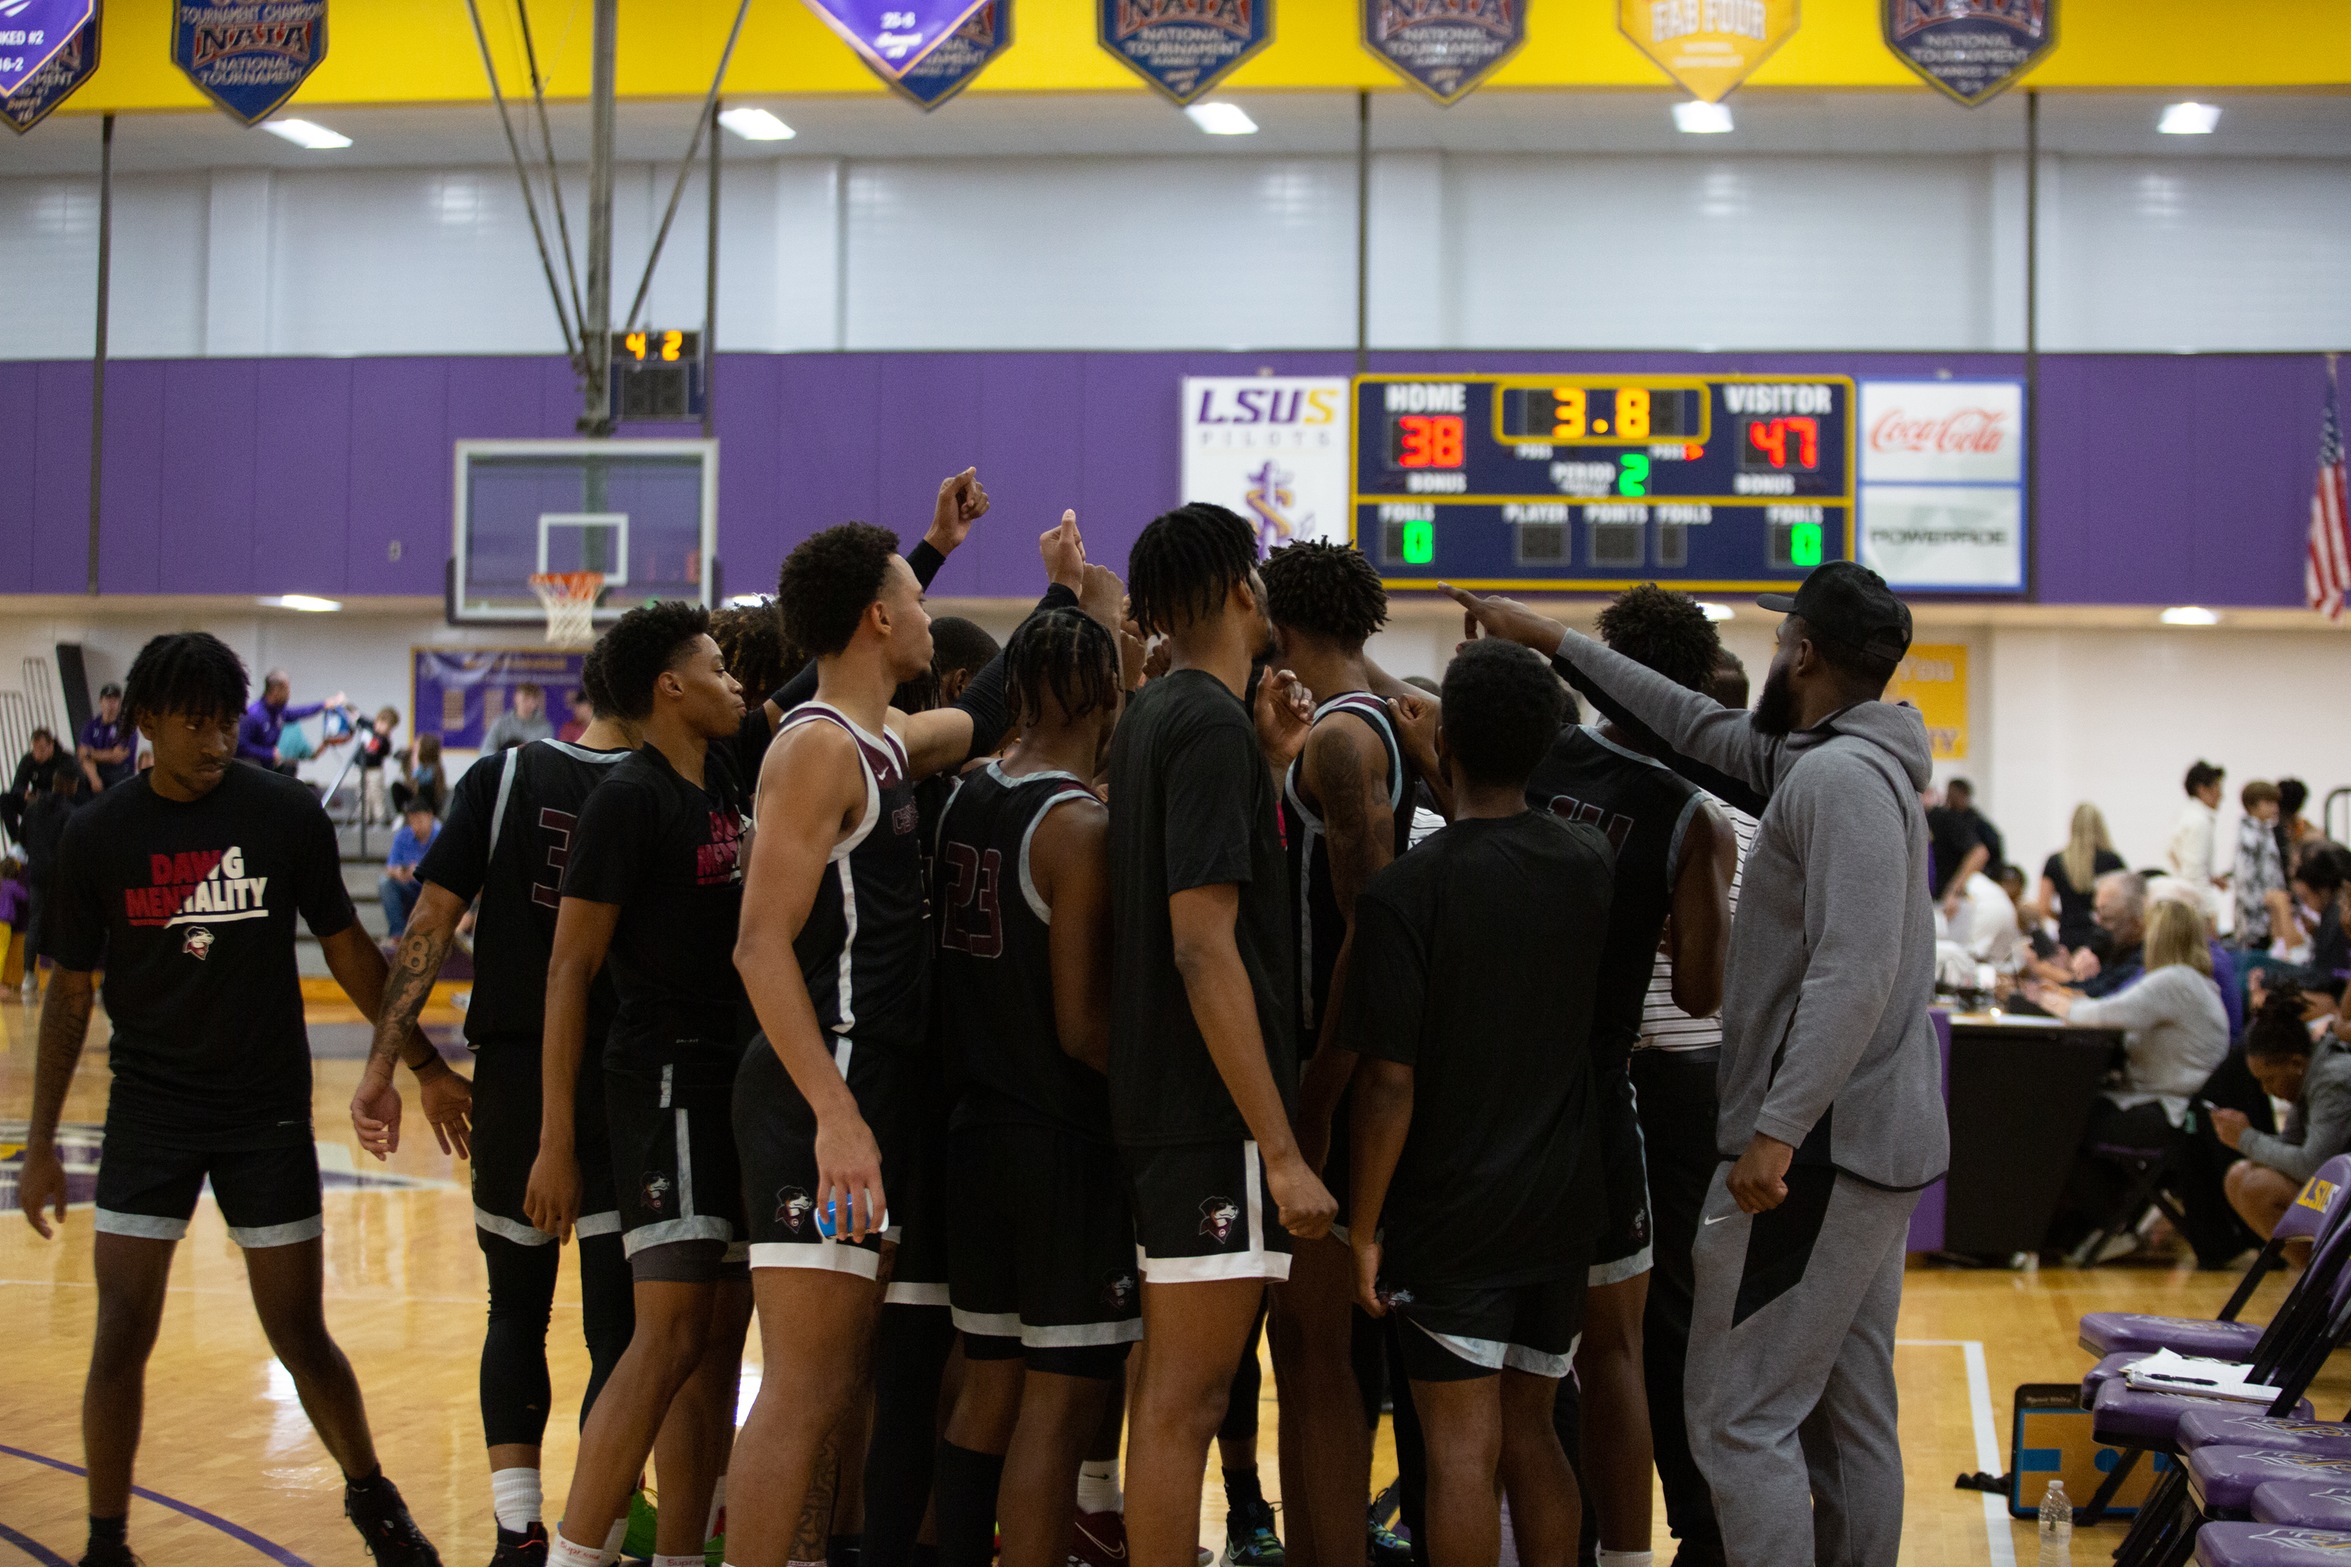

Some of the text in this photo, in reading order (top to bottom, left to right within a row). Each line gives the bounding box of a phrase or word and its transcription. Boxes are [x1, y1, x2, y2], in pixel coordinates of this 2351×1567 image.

[1138, 27, 1229, 41] NATIONAL
[1402, 27, 1487, 41] NATIONAL
[1124, 40, 1245, 57] TOURNAMENT
[1386, 40, 1504, 57] TOURNAMENT
[214, 56, 294, 72] NATIONAL
[201, 66, 304, 86] TOURNAMENT
[1198, 388, 1340, 425] LSUS
[1385, 384, 1467, 412] HOME
[1724, 384, 1832, 413] VISITOR
[1552, 387, 1650, 439] 3.8
[1201, 431, 1331, 446] PILOTS
[1400, 415, 1464, 468] 38
[1870, 407, 2008, 454] Coca-Cola
[1750, 416, 1817, 468] 47
[1407, 472, 1467, 493] BONUS
[1551, 461, 1616, 483] PERIOD
[1618, 453, 1649, 497] 2
[1735, 473, 1795, 495] BONUS
[1378, 504, 1435, 522] FOULS
[1502, 503, 1569, 524] PLAYER
[1583, 503, 1649, 524] POINTS
[1654, 504, 1712, 525] FOULS
[1765, 505, 1823, 524] FOULS
[1403, 520, 1434, 564] 0
[1791, 522, 1823, 566] 0
[151, 846, 245, 886] DAWG
[125, 877, 268, 918] MENTALITY
[942, 841, 1003, 959] 23
